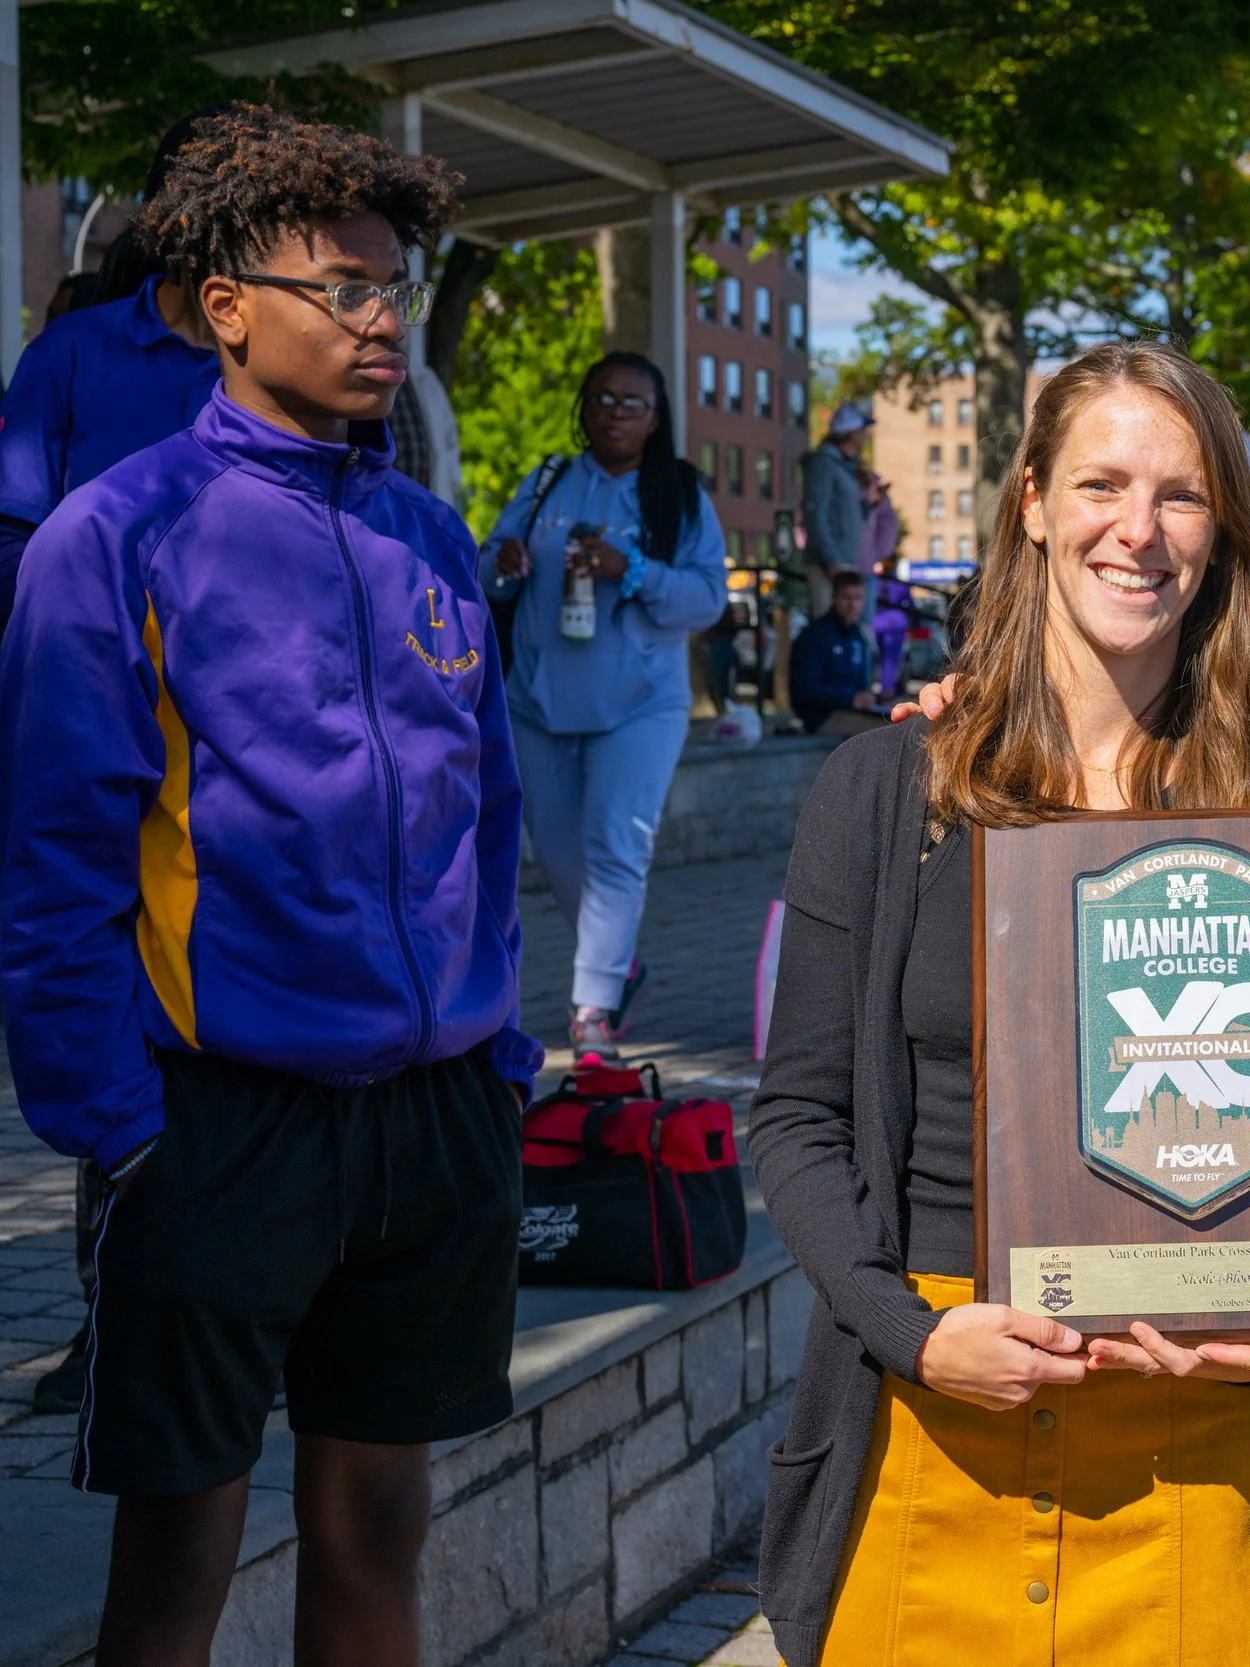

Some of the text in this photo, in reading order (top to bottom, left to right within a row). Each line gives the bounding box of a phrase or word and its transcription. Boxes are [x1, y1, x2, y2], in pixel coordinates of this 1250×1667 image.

[427, 588, 445, 629] L
[405, 631, 438, 672] TRACK
[452, 649, 479, 672] FIELD
[1105, 872, 1136, 893] VAN
[1144, 853, 1228, 873] CORTLANDT
[1169, 886, 1207, 898] JASPERS
[1143, 957, 1238, 977] COLLEGE
[1156, 1143, 1236, 1168] HOKA
[1172, 1173, 1221, 1182] TIME TO FLY
[1108, 1249, 1130, 1259] Van
[1133, 1247, 1186, 1259] Cortlandt
[1190, 1246, 1215, 1257] Park
[1219, 1245, 1250, 1257] Cross
[1040, 1261, 1072, 1270] MANHATTAN
[1177, 1271, 1215, 1285] Nicole
[1211, 1299, 1244, 1307] October
